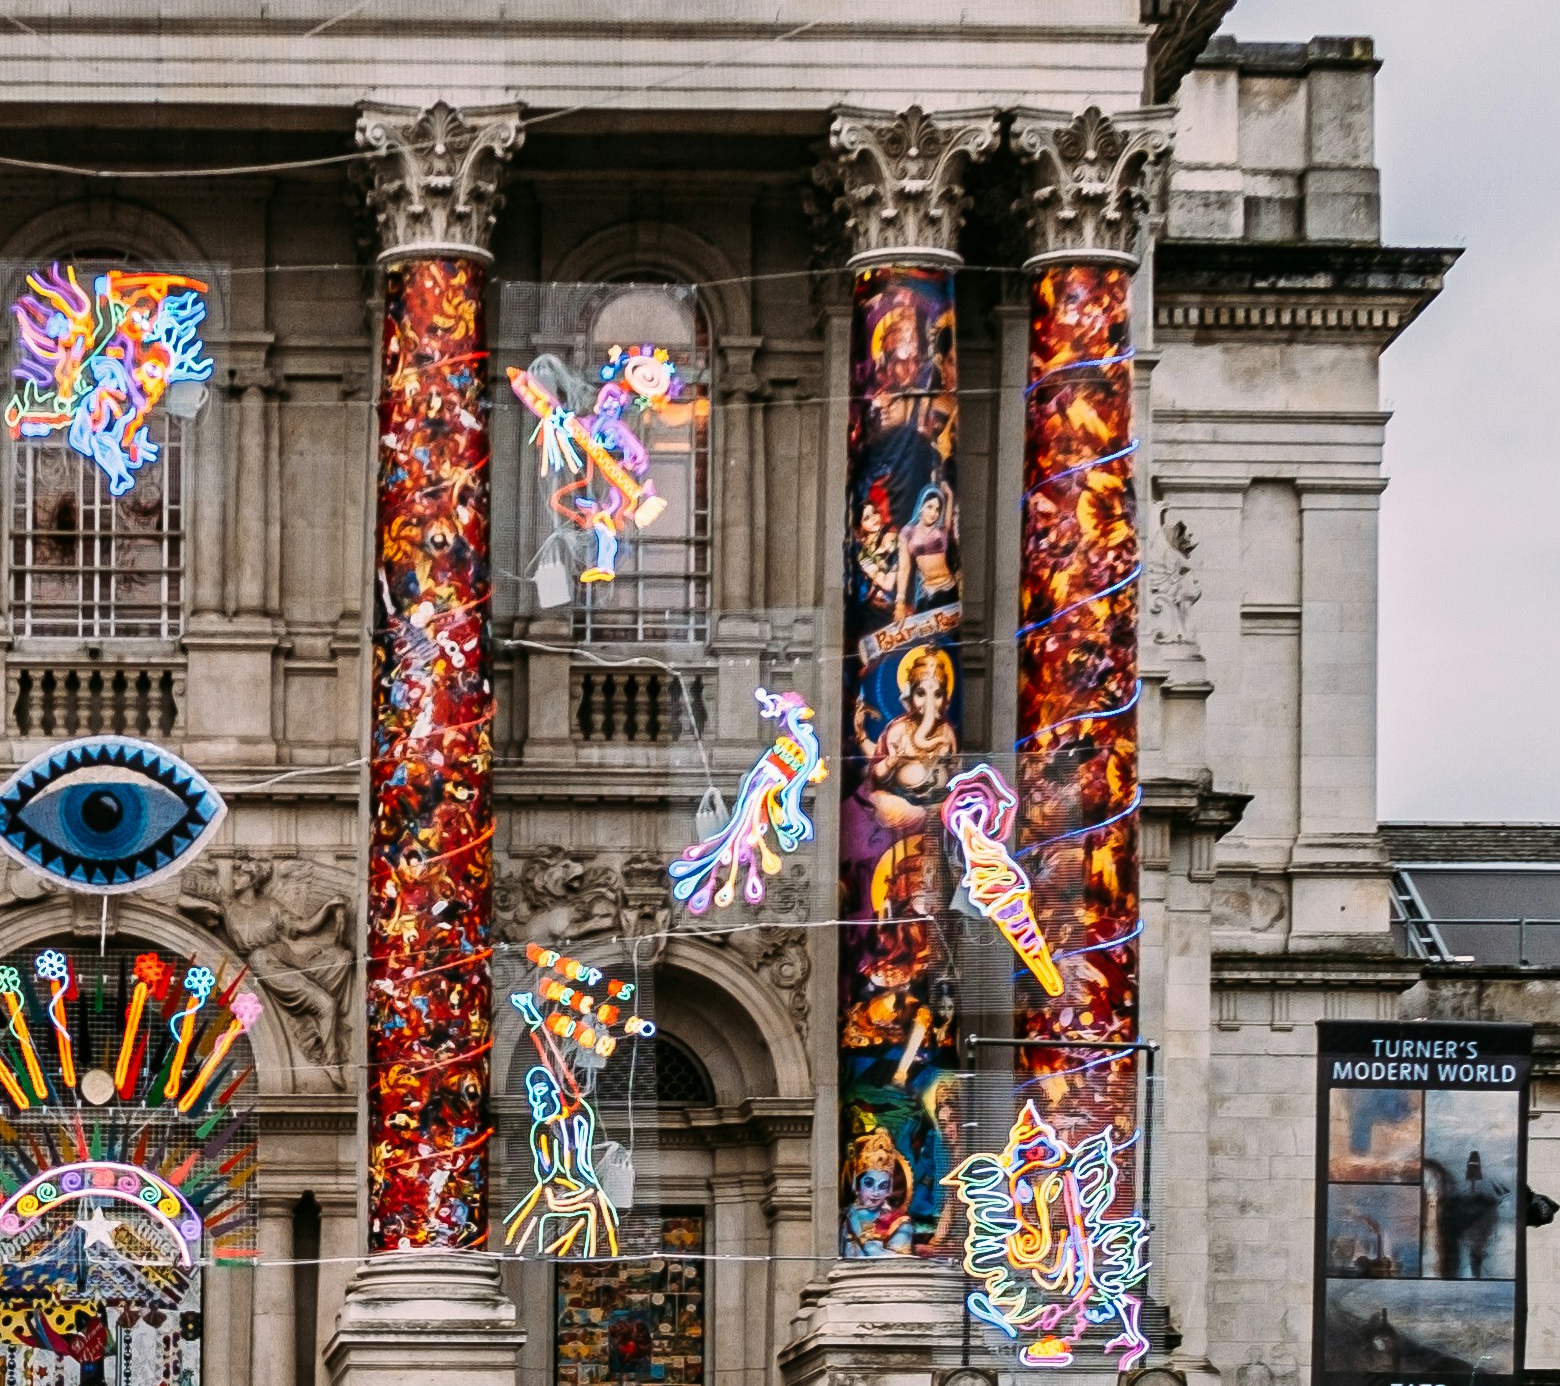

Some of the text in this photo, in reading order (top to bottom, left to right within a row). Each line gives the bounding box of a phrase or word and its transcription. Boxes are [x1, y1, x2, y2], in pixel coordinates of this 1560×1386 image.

[1371, 1039, 1479, 1060] TURNER'S
[1332, 1061, 1517, 1083] MODERN WORLD
